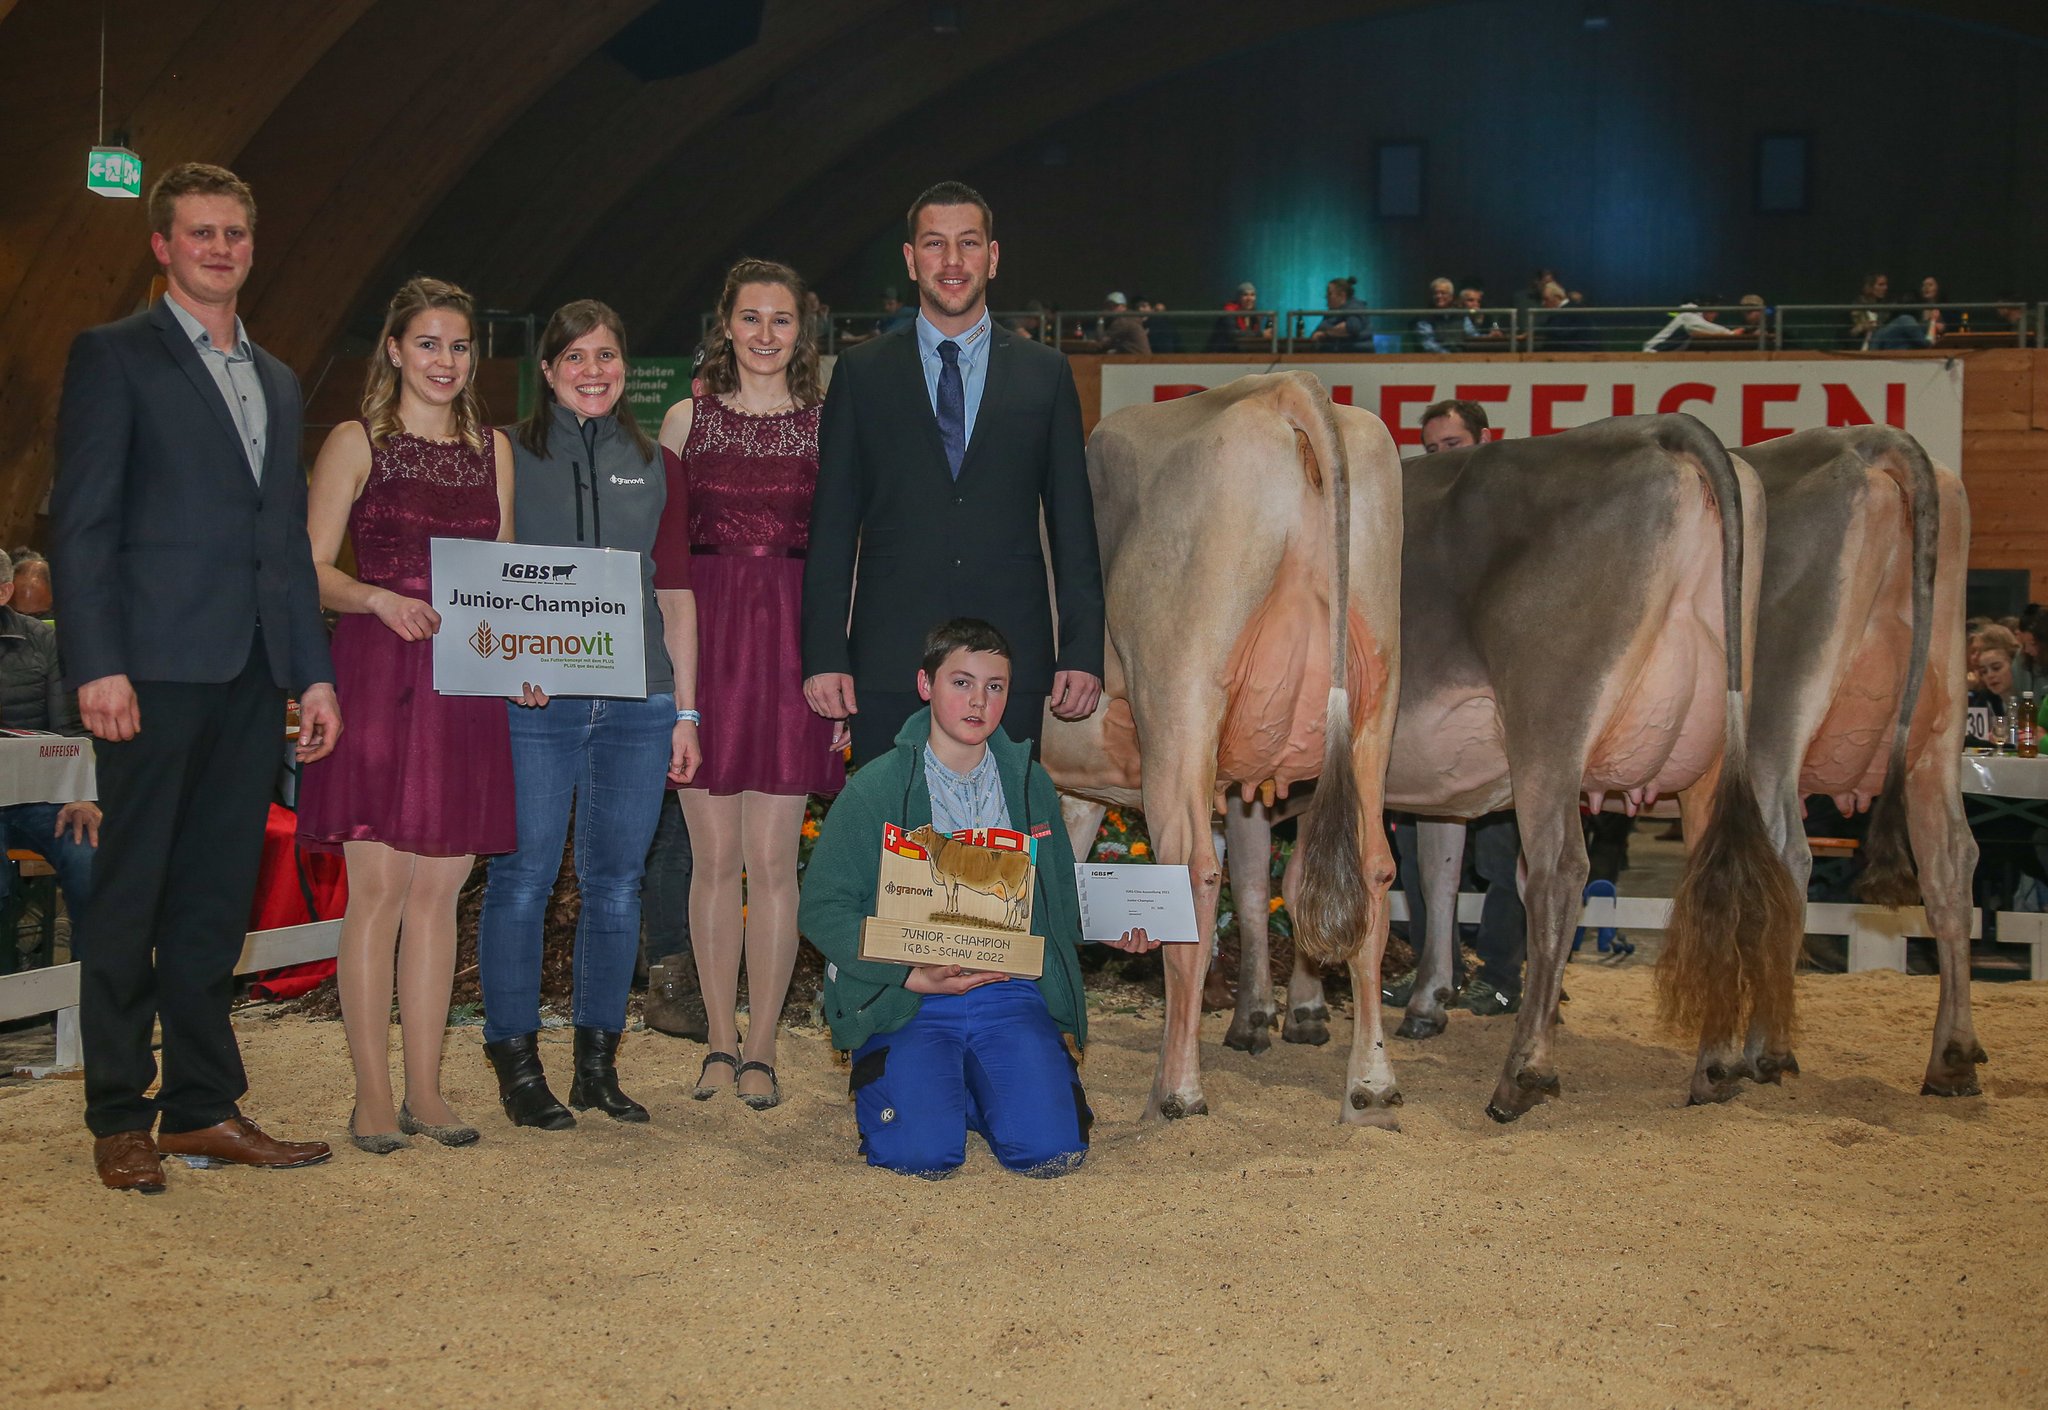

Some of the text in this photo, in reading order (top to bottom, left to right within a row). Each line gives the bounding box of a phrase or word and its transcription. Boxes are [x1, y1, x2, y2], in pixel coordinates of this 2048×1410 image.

[617, 477, 645, 485] granovit
[502, 563, 551, 580] IGBS
[449, 589, 626, 617] Junior-Champion
[501, 631, 614, 660] granovit
[40, 745, 80, 757] RAIFFEISEN
[896, 885, 933, 897] granovit
[976, 951, 1004, 963] 2022
